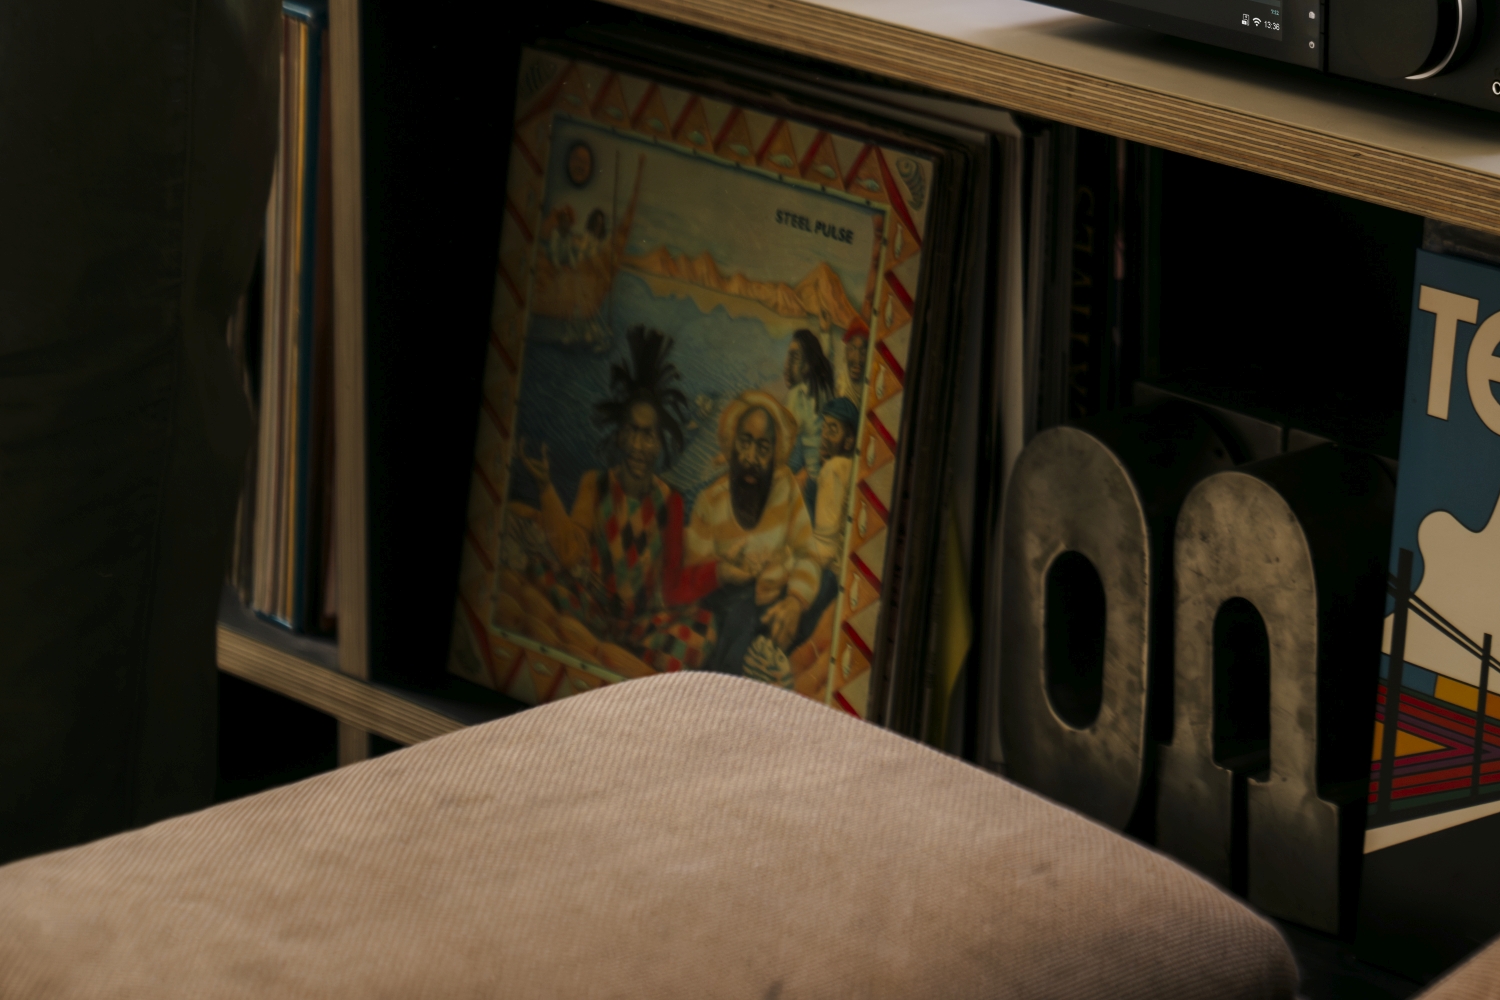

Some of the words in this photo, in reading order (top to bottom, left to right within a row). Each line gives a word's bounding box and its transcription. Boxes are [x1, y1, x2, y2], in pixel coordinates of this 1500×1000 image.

[1264, 20, 1280, 31] 13:36
[775, 209, 812, 233] STEEL
[814, 219, 854, 245] PULSE
